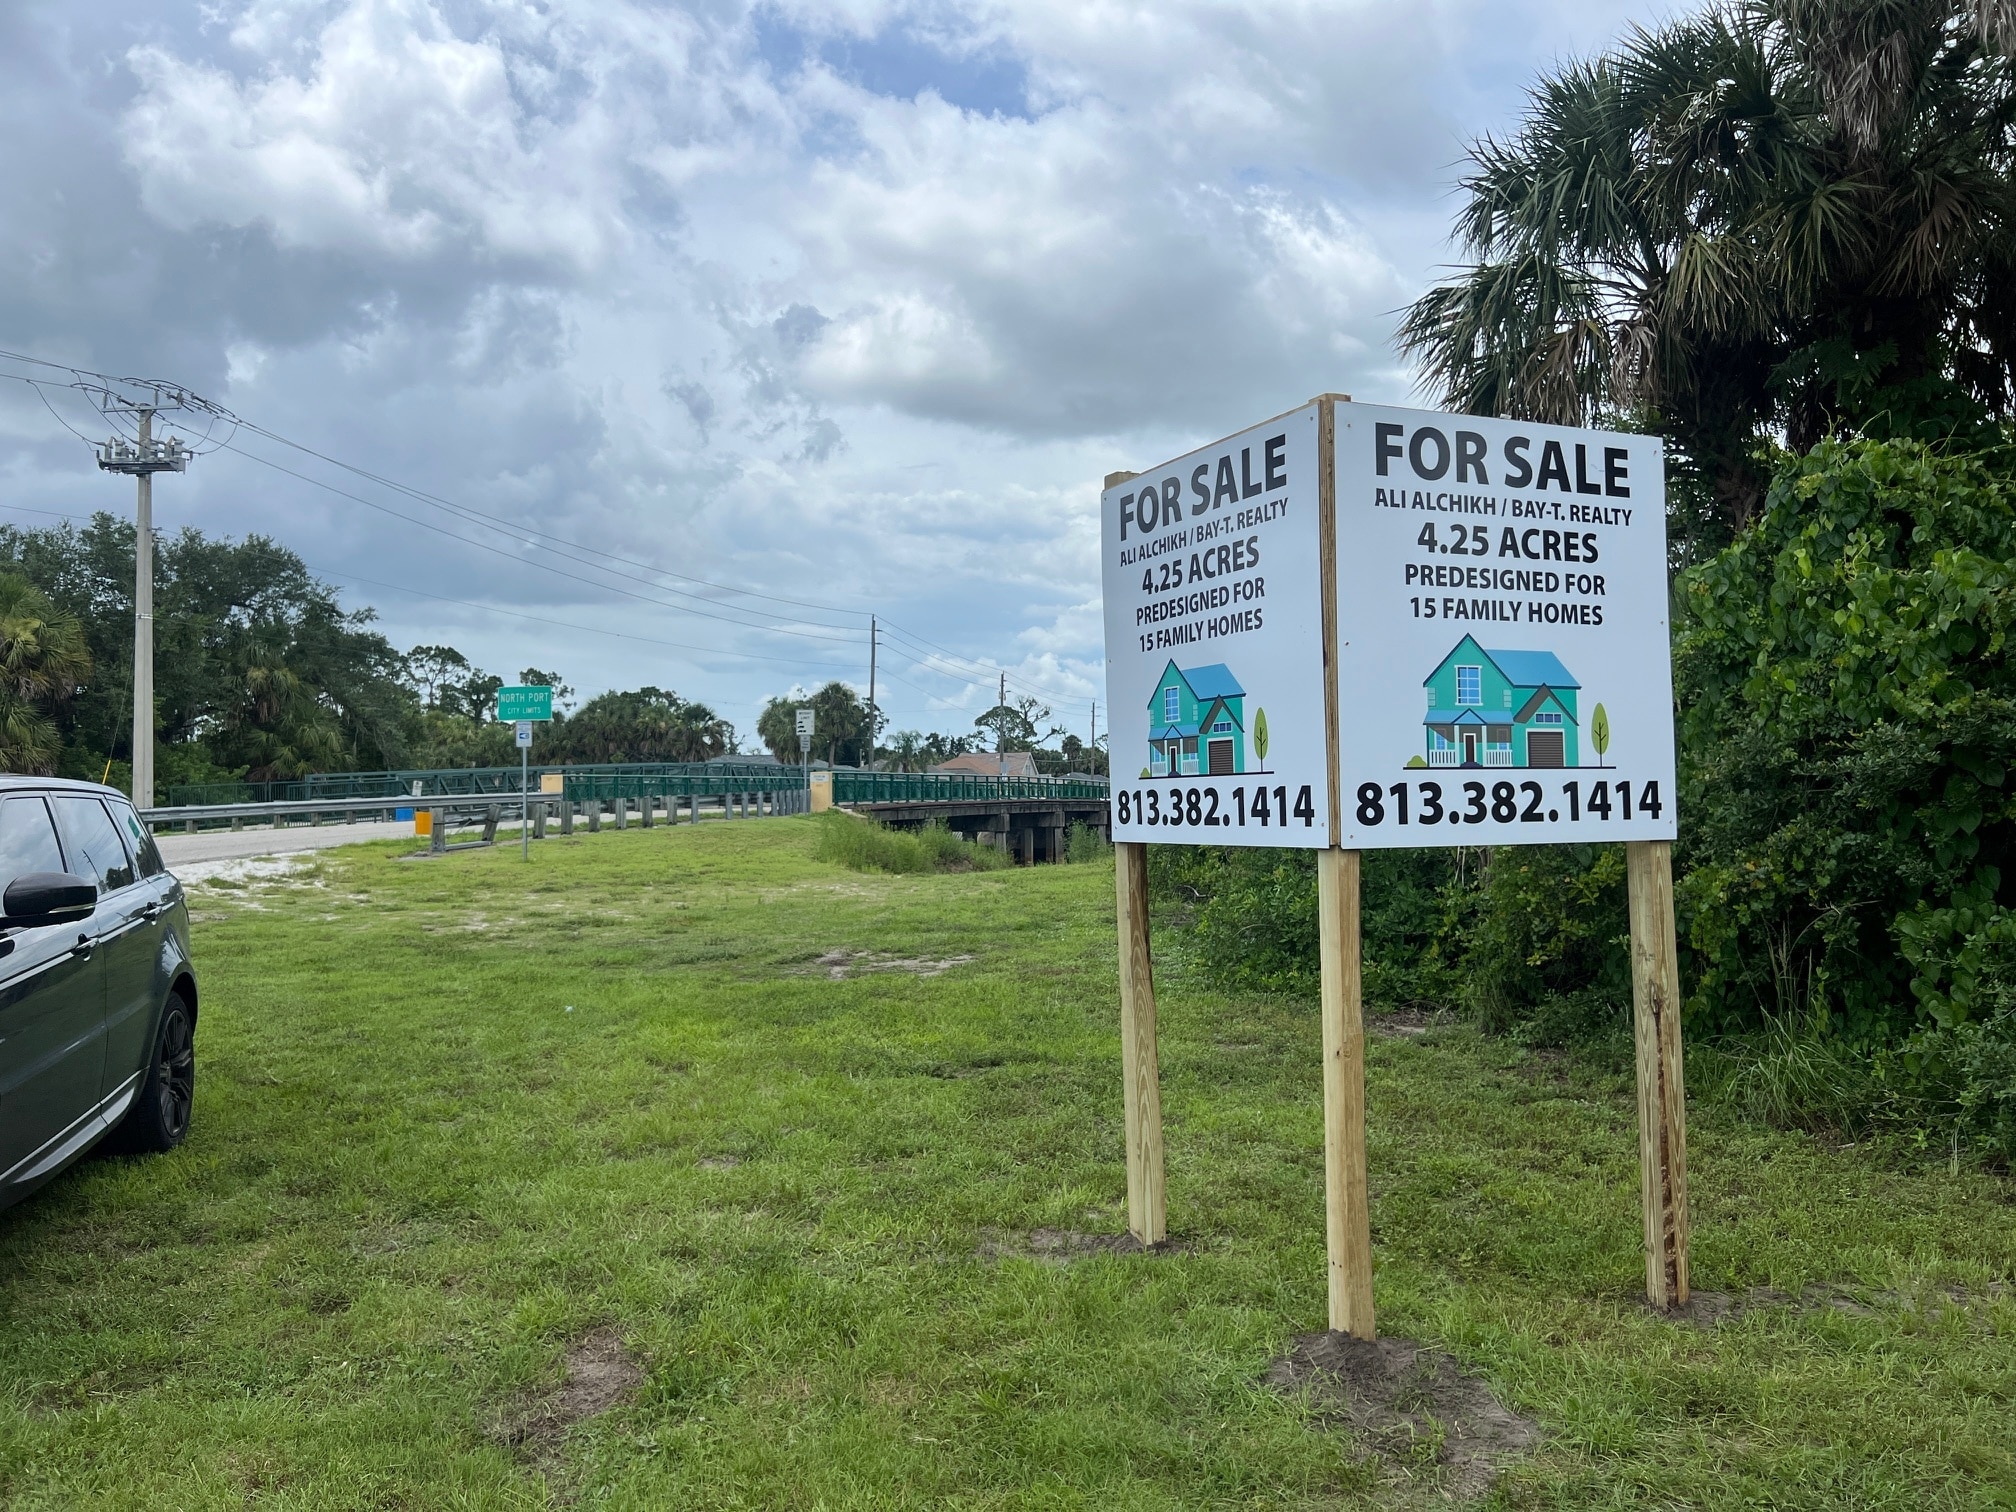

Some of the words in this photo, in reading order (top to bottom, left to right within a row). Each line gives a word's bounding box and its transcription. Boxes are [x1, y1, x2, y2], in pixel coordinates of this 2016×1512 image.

[1374, 421, 1490, 486] FOR
[1503, 436, 1631, 499] SALE
[1119, 477, 1183, 542] FOR
[1190, 433, 1288, 516] SALE
[1374, 487, 1406, 509] ALI
[1411, 491, 1497, 516] ALCHIKH
[1511, 499, 1567, 523] BAY-T.
[1569, 504, 1633, 527] REALTY
[1119, 547, 1138, 568] ALI
[1138, 530, 1188, 562] ALCHIKH
[1196, 515, 1236, 543] BAY-T.
[1237, 497, 1289, 531] REALTY
[1417, 522, 1490, 557] 4.25
[1498, 526, 1599, 564] ACRES
[1142, 558, 1184, 595] 4.25
[1188, 535, 1260, 584] ACRES
[1405, 563, 1560, 593] PREDESIGNED
[1565, 573, 1606, 596] FOR
[1136, 586, 1230, 627] PREDESIGNED
[1233, 577, 1265, 604] FOR
[1410, 596, 1437, 619] 15
[1442, 597, 1523, 622] FAMILY
[1528, 601, 1603, 626] HOMES
[1139, 632, 1154, 653] 15
[1156, 620, 1204, 650] FAMILY
[1207, 608, 1263, 639] HOMES
[500, 693, 525, 703] NORTH
[528, 692, 549, 702] PORT
[507, 707, 520, 715] CITY
[522, 706, 541, 714] LIMITS
[1117, 784, 1315, 828] 813.382.1414
[1356, 779, 1663, 828] 813.382.1414
